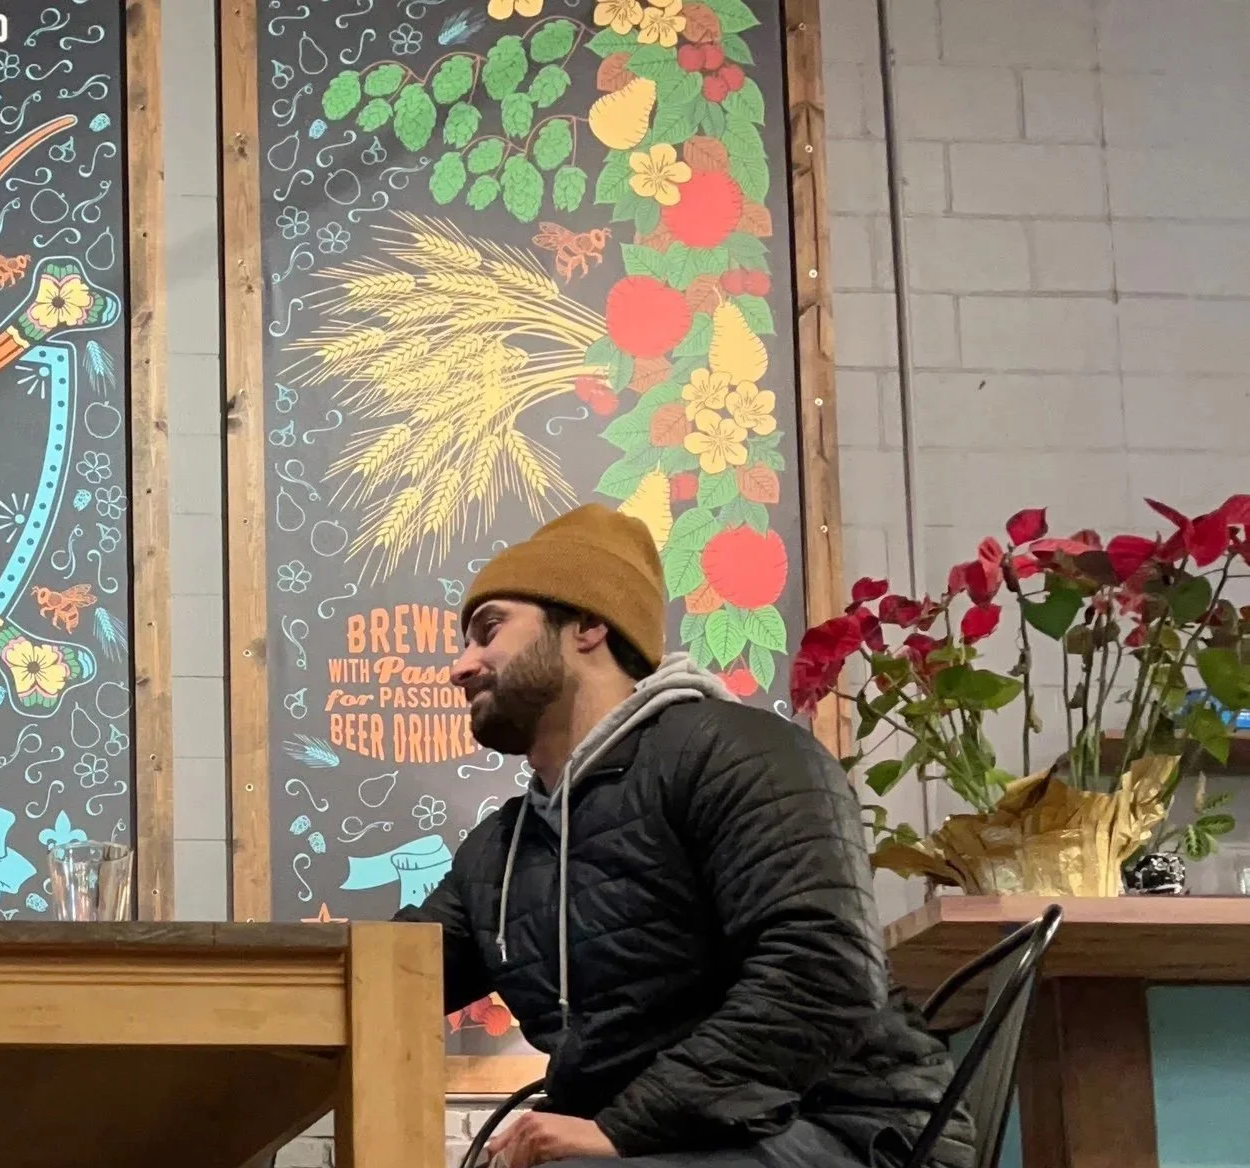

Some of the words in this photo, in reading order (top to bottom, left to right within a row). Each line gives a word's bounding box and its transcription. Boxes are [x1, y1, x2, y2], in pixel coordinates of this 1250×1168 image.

[347, 604, 459, 654] BREWE
[328, 658, 370, 684] WITH
[373, 656, 459, 685] Pass
[324, 689, 374, 712] for
[380, 686, 471, 709] PASSION
[330, 713, 385, 761] BEER
[393, 713, 483, 763] DRINKE
